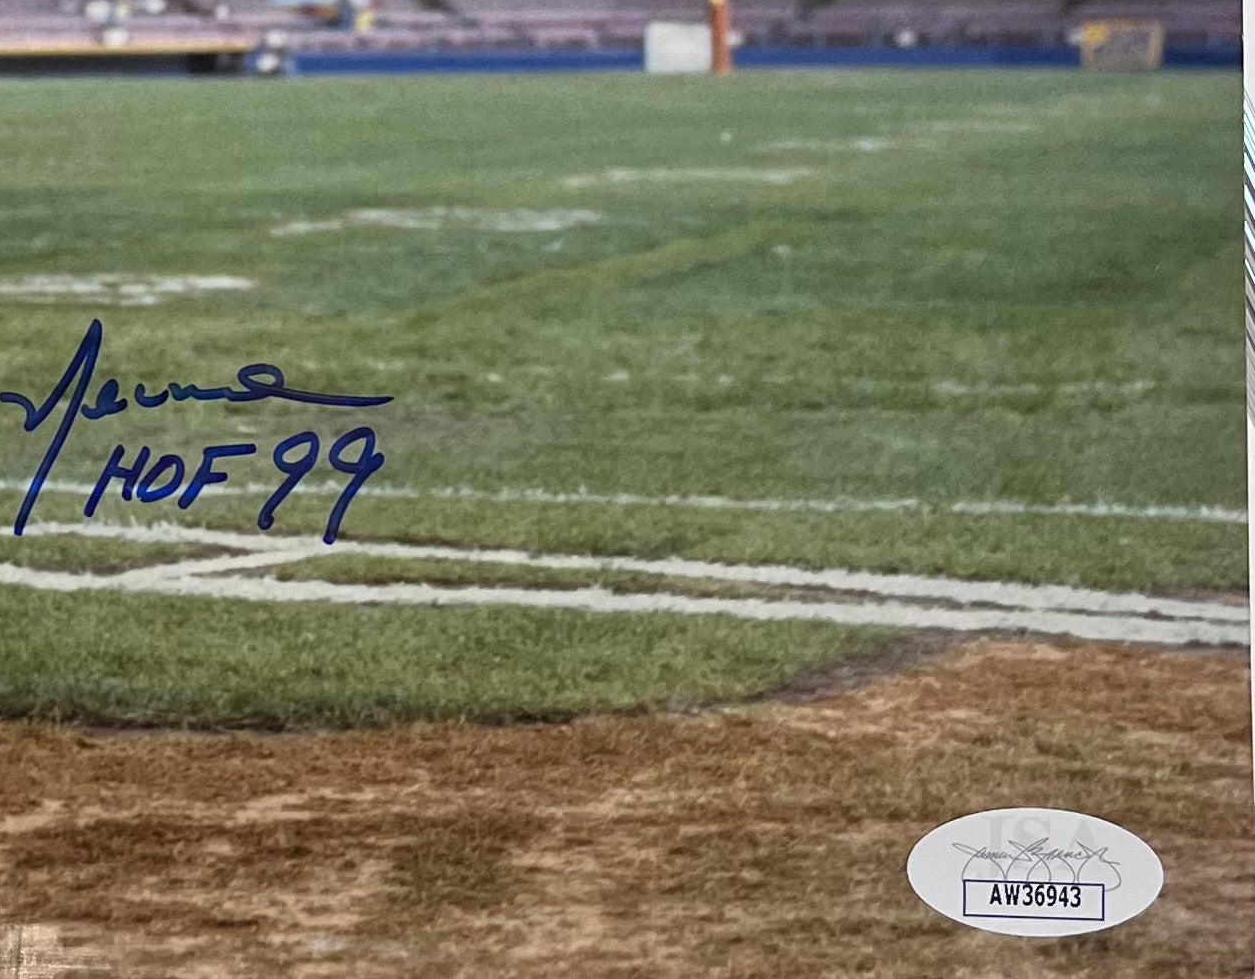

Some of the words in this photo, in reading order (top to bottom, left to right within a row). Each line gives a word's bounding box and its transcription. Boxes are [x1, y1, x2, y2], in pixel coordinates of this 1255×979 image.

[84, 443, 257, 518] HOF
[259, 426, 386, 547] 99
[990, 884, 1082, 908] AW36943
